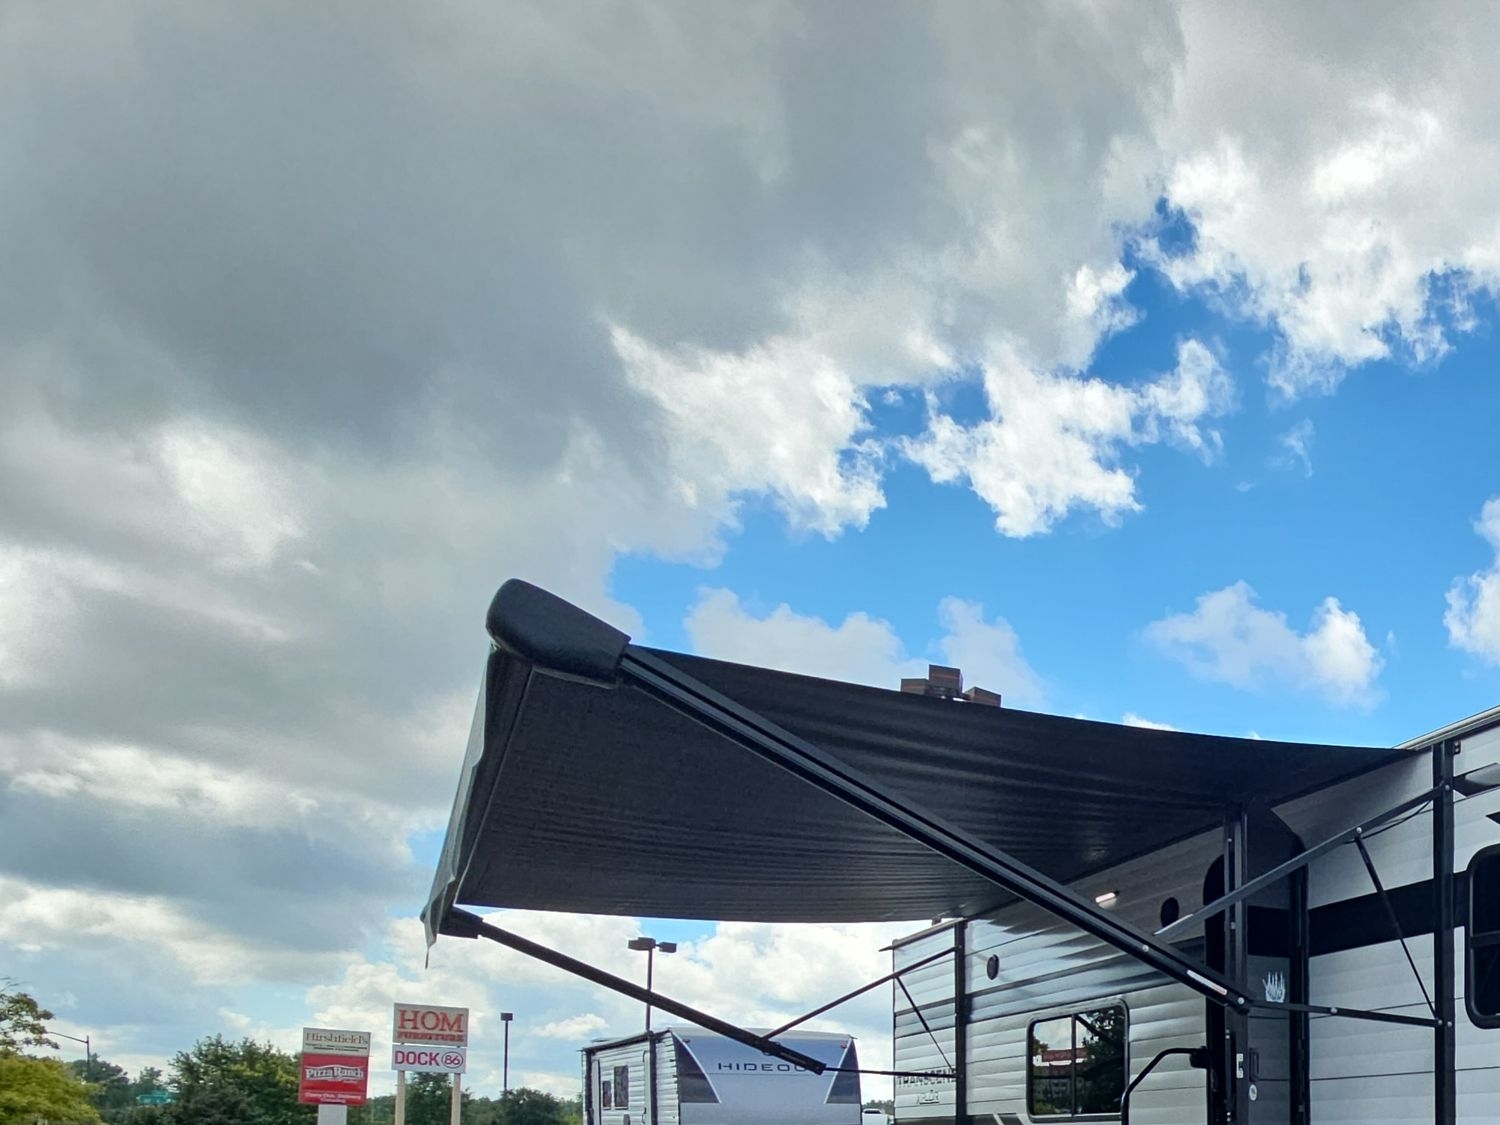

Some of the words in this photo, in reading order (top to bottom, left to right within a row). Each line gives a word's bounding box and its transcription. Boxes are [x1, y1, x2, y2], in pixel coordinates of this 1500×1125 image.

[398, 1009, 464, 1033] HOM
[394, 1050, 440, 1067] DOCK
[444, 1054, 461, 1066] 86
[305, 1067, 333, 1079] Pizza
[333, 1066, 364, 1079] Ranch
